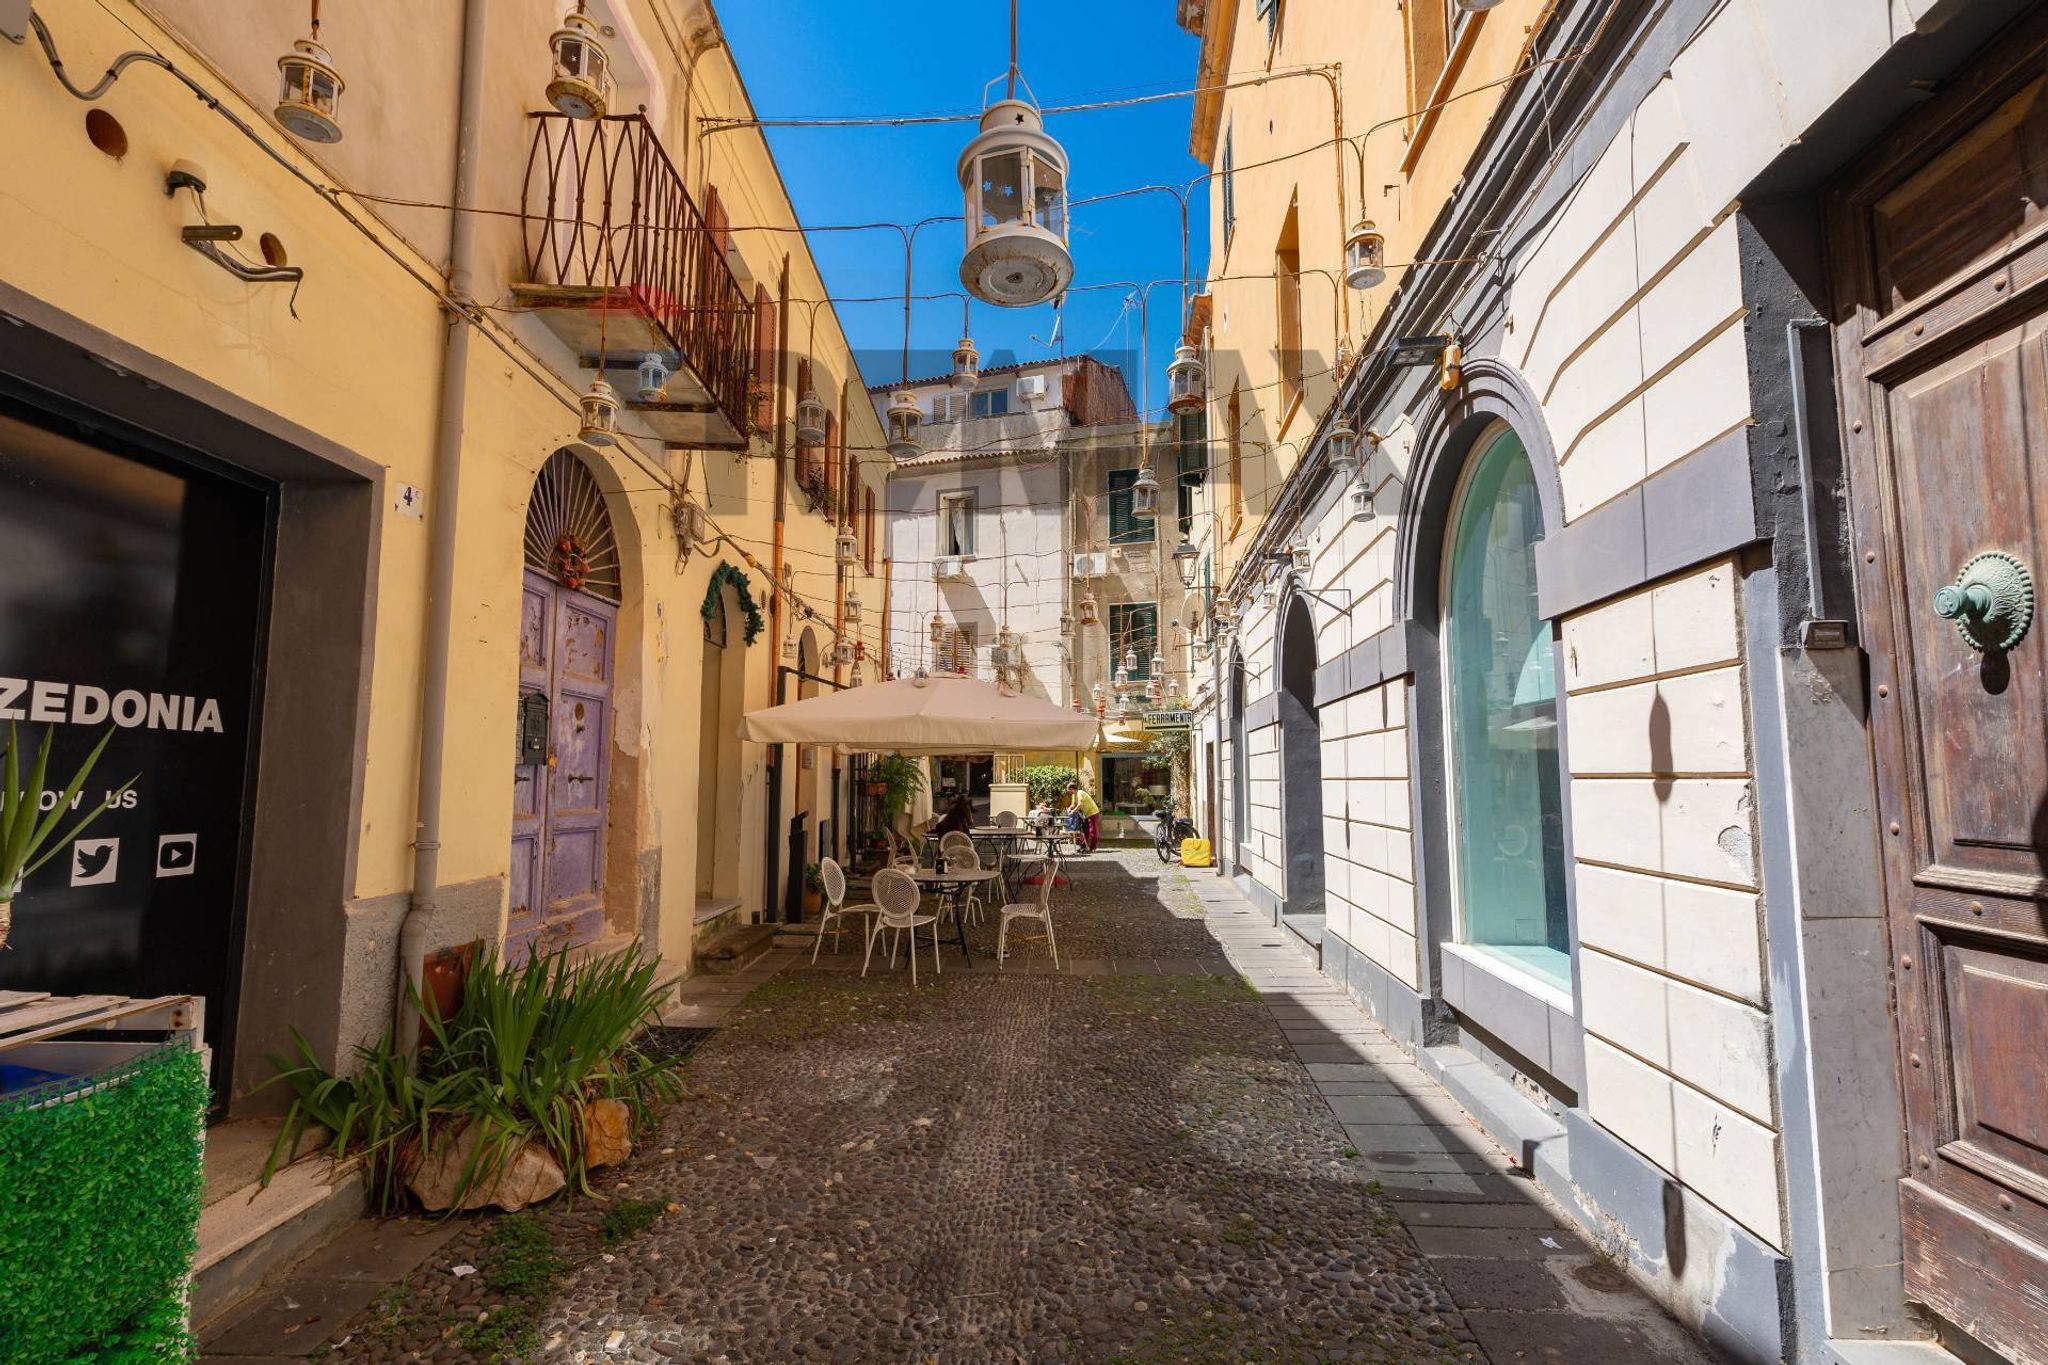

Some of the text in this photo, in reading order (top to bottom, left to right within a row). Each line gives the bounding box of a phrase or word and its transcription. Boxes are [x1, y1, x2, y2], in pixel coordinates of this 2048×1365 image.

[403, 486, 413, 507] 4
[0, 677, 224, 733] ZEDONIA
[105, 789, 138, 809] US
